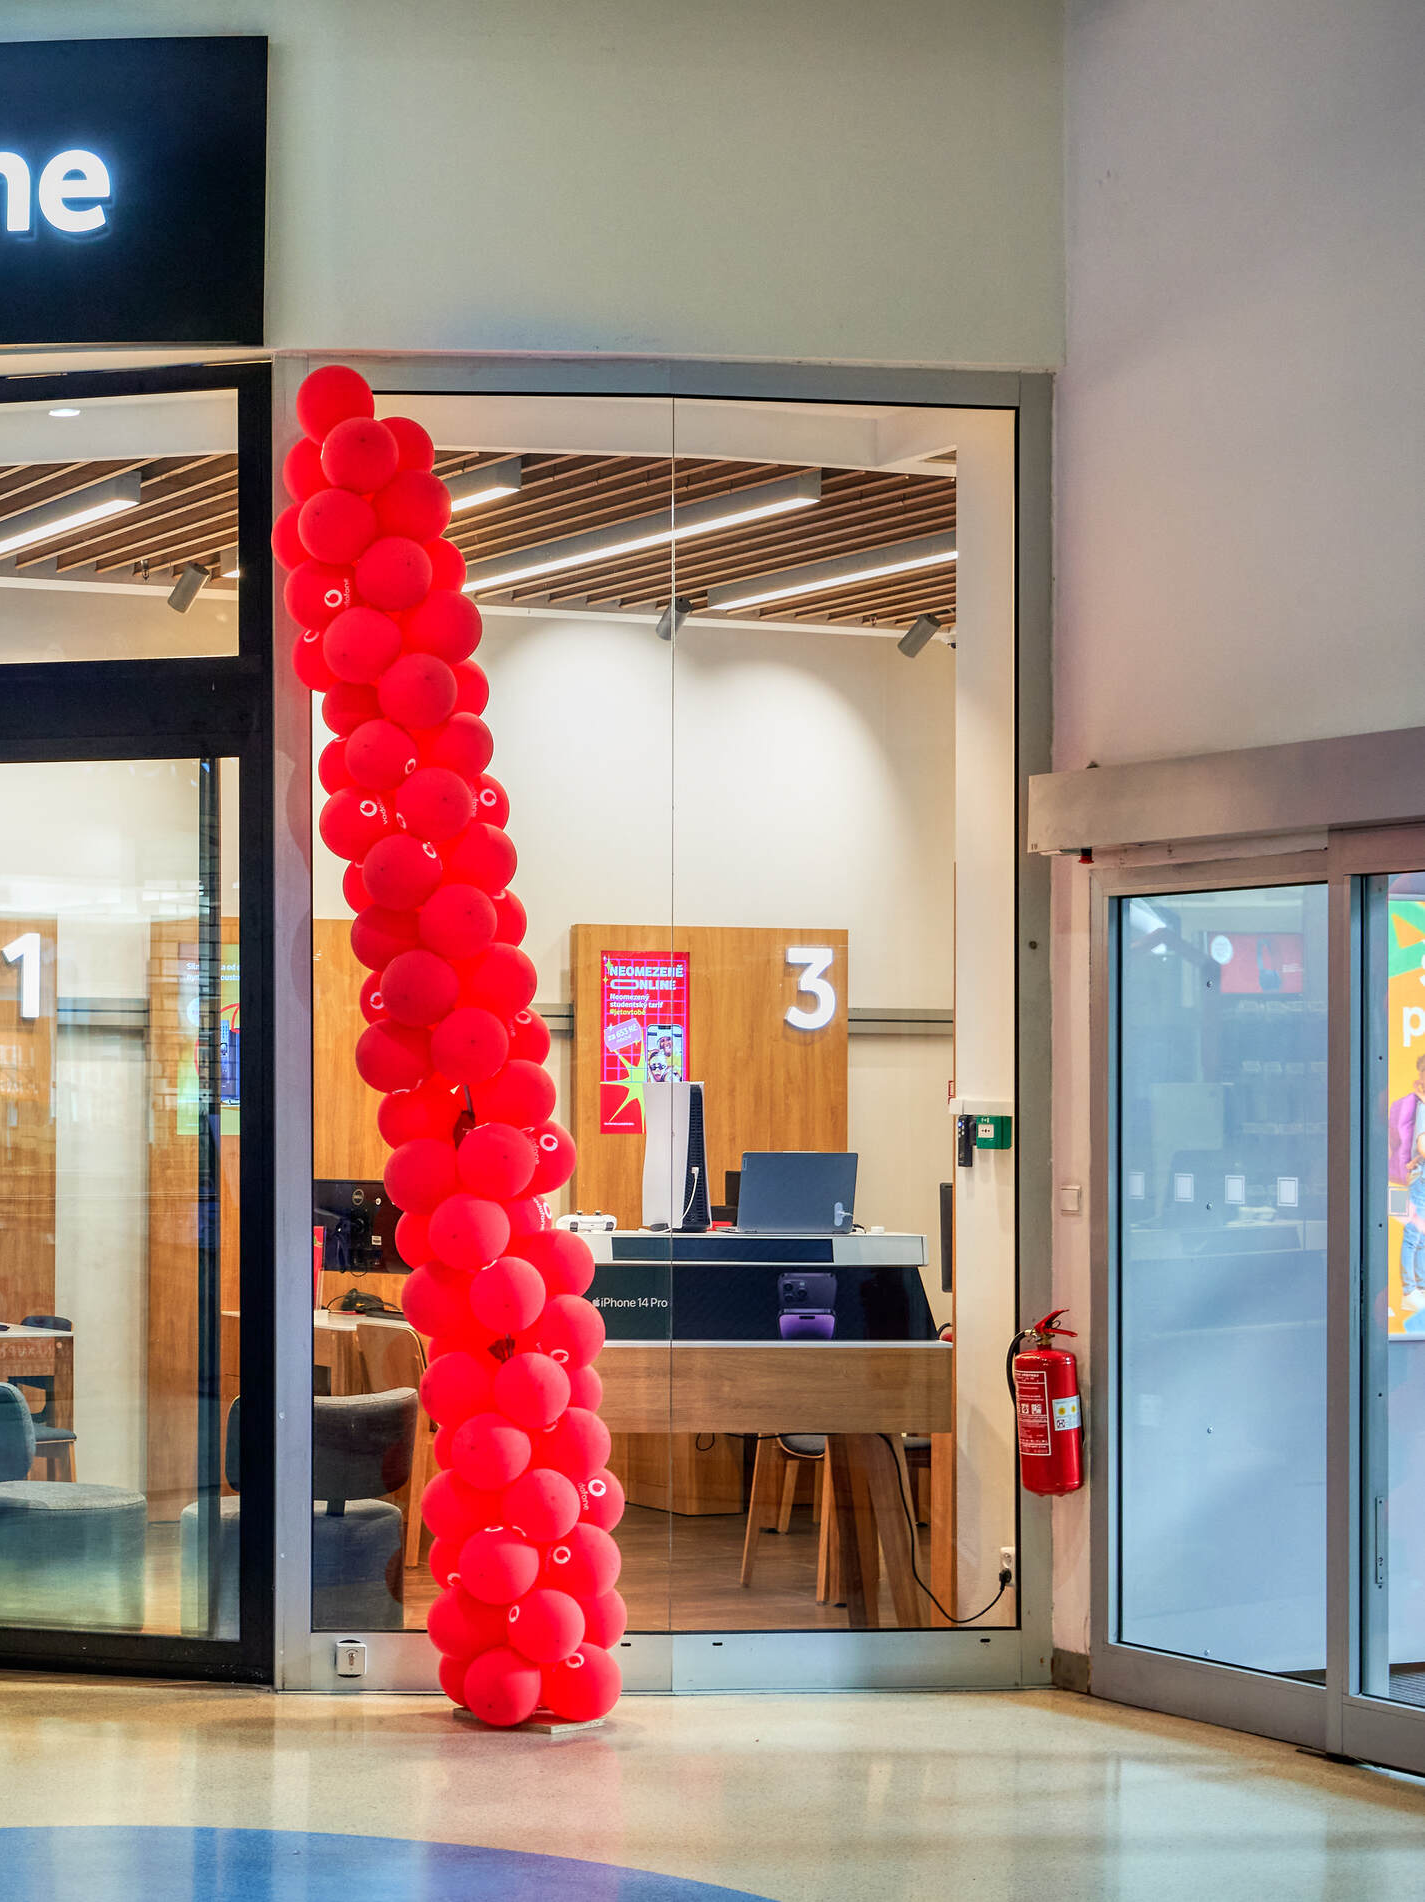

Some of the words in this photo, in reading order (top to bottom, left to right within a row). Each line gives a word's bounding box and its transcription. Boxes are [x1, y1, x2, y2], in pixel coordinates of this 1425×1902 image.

[1, 932, 41, 1018] 1
[609, 964, 684, 977] NEOMEZENĚ
[609, 978, 676, 990] ONLINE
[785, 947, 836, 1029] 3
[600, 1297, 636, 1308] iPhone
[637, 1297, 649, 1307] 14
[650, 1297, 668, 1308] Pro
